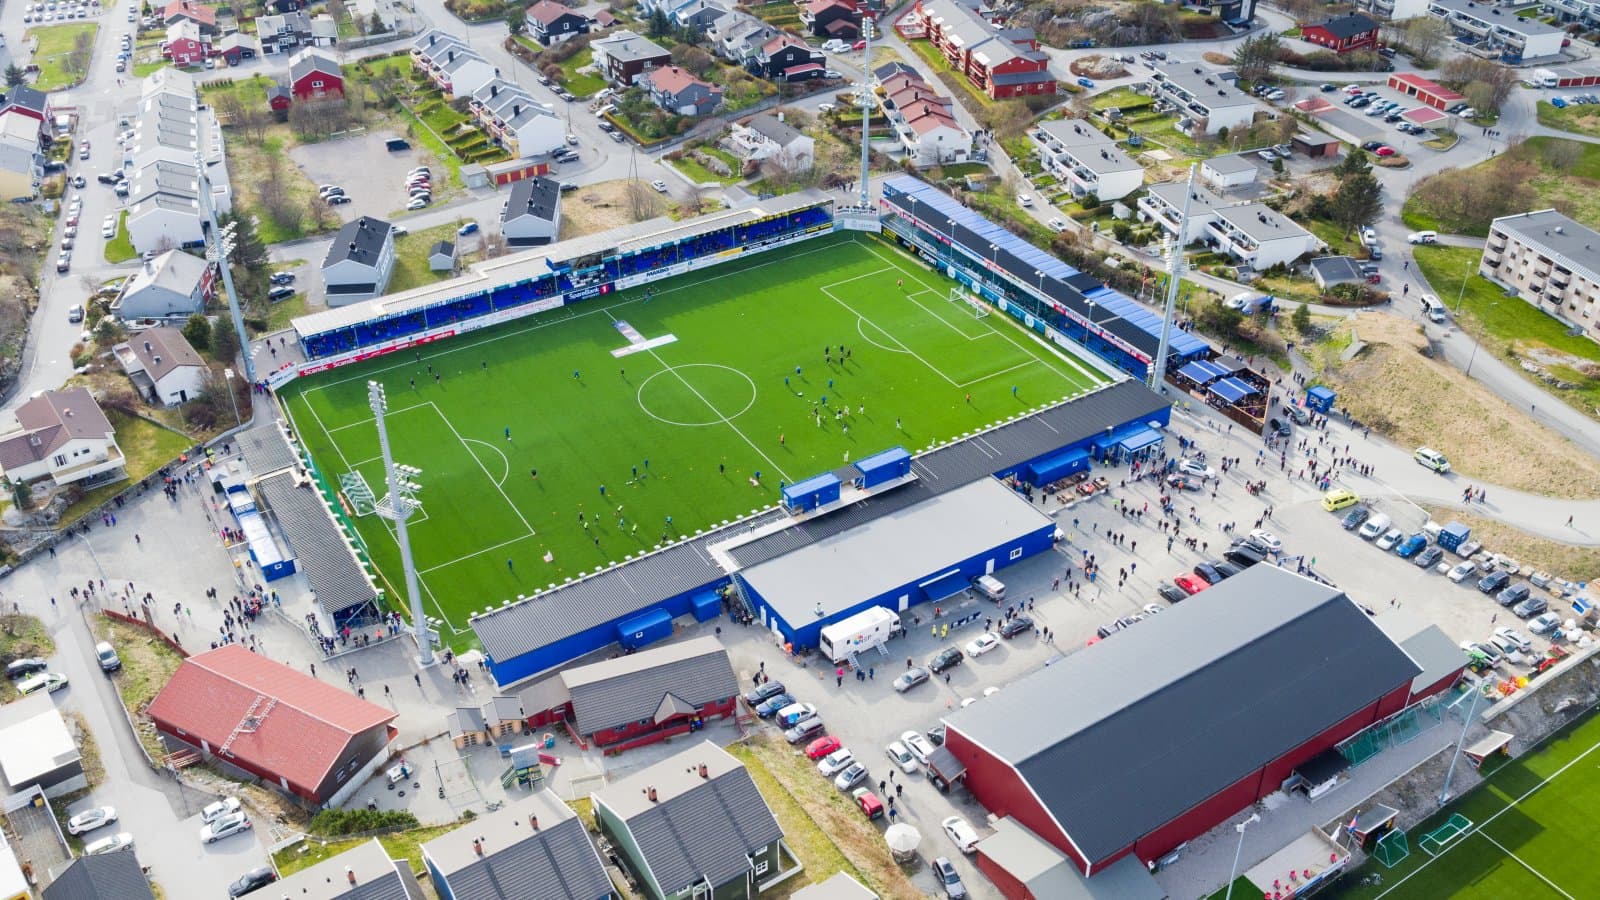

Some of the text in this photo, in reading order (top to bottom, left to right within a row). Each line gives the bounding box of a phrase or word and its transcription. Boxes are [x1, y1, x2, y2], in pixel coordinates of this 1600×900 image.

[568, 287, 599, 299] SpareBank
[303, 364, 328, 376] Scandic
[334, 356, 357, 368] Scandic
